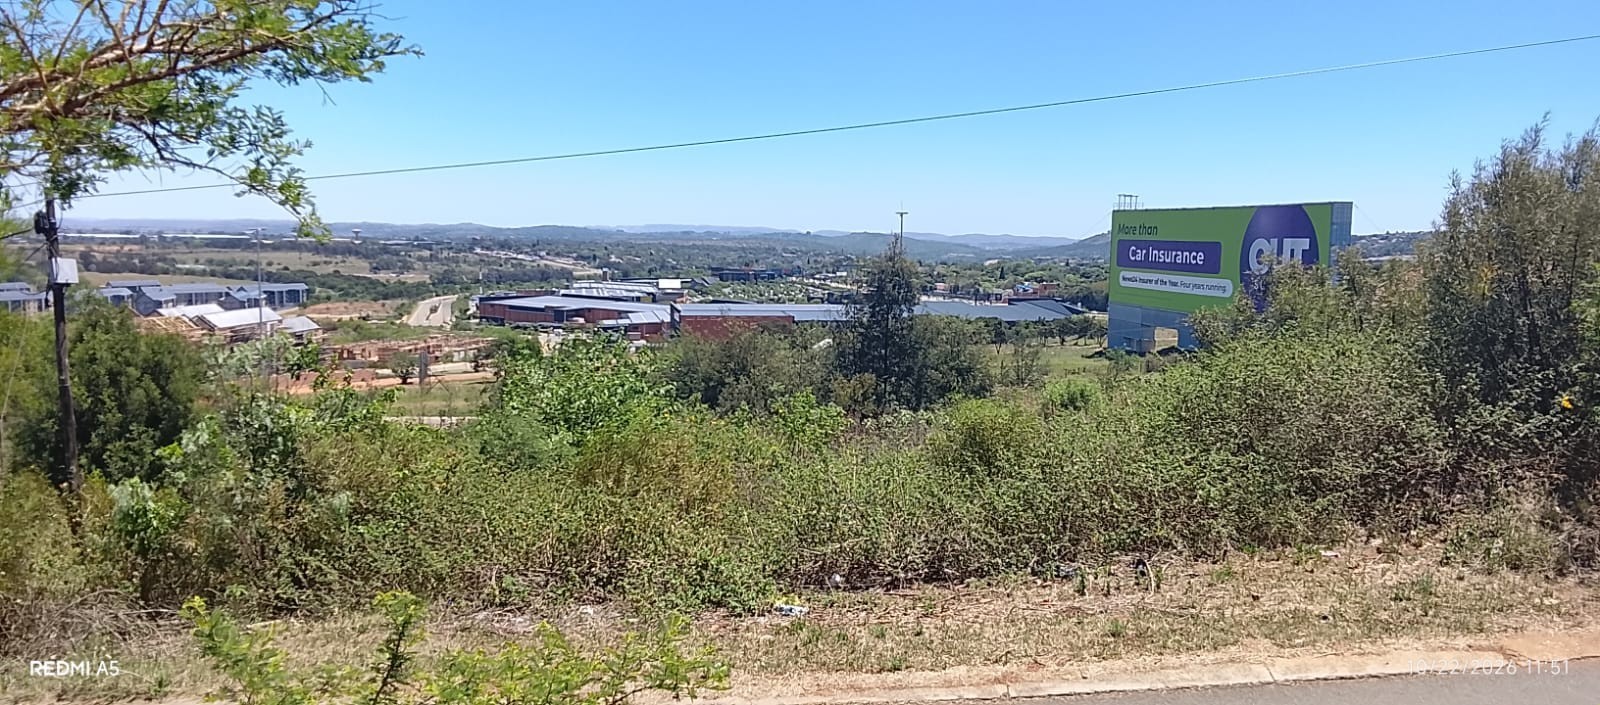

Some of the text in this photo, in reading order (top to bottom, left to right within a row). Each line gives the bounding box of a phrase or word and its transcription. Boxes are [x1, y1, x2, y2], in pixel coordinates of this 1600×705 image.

[1117, 223, 1158, 236] More than
[1129, 245, 1205, 265] Car Insurance
